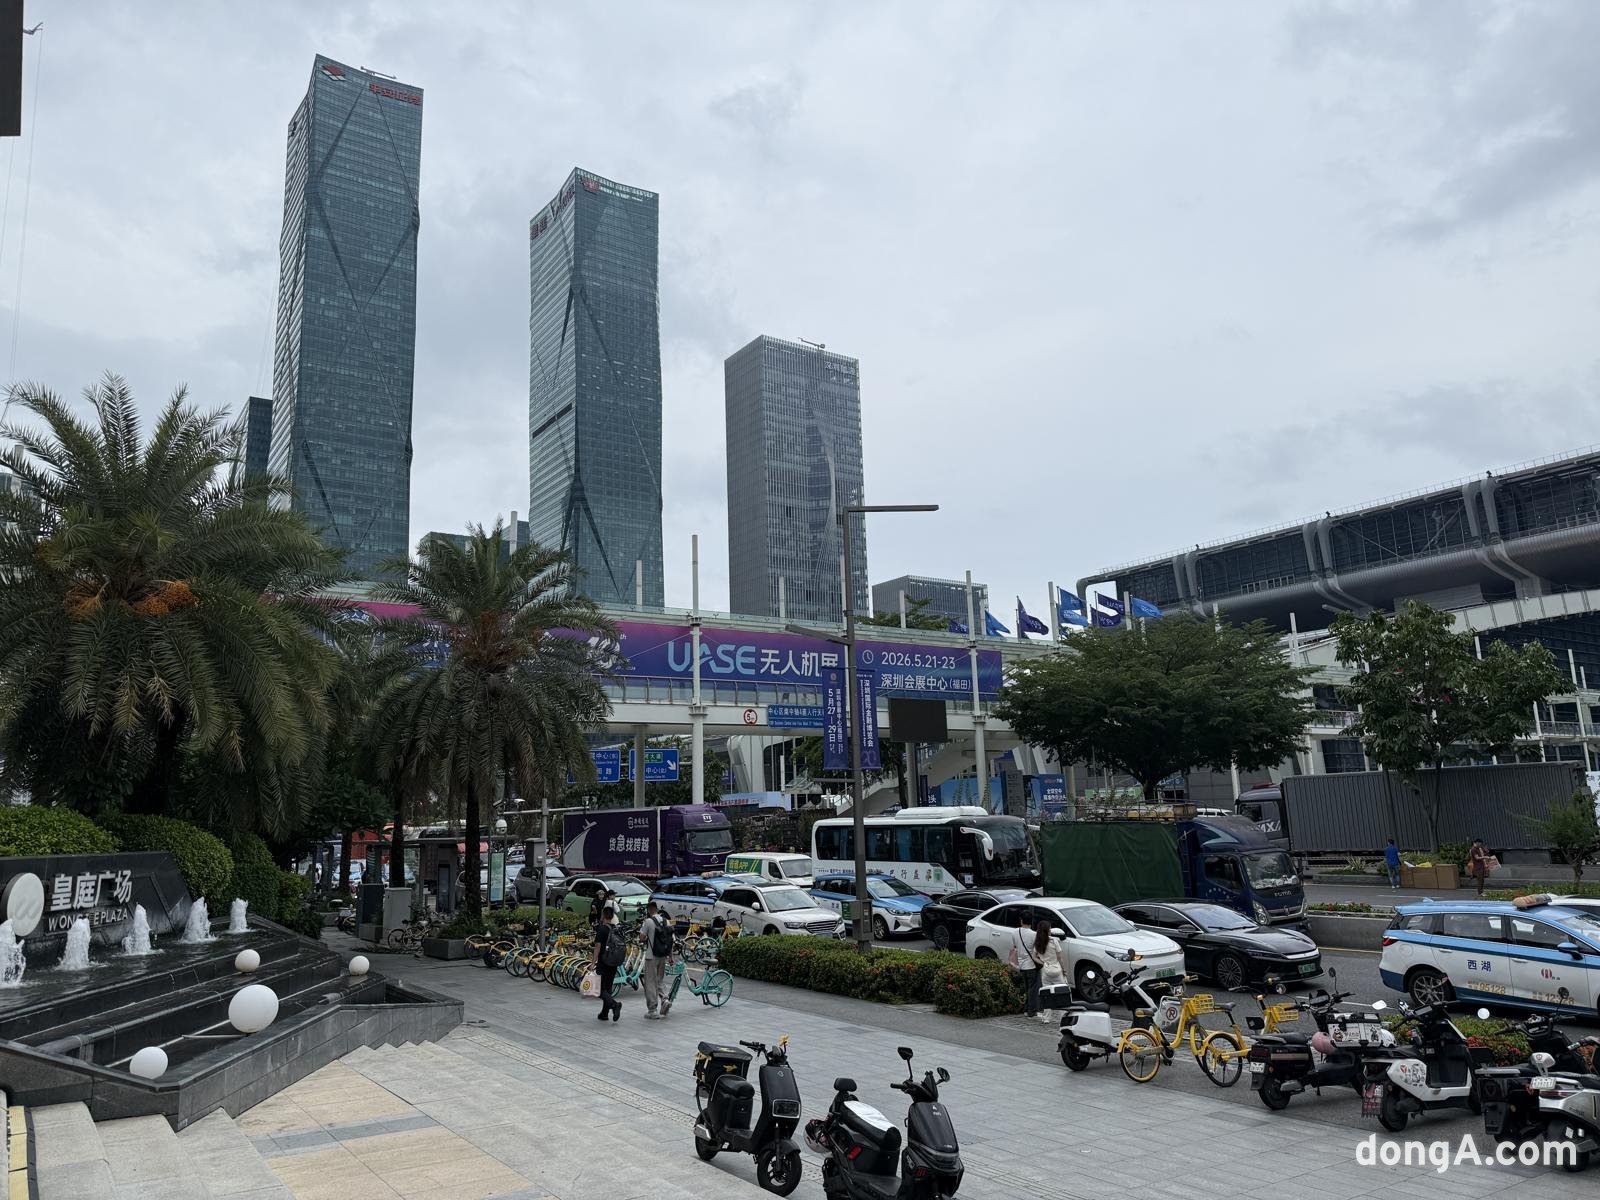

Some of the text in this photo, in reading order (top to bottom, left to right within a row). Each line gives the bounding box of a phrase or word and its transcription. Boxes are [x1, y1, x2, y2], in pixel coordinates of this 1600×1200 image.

[667, 641, 756, 675] UASE
[881, 652, 956, 669] 2026.5.21-23
[609, 834, 649, 852] 货急找跨越
[50, 870, 132, 911] 皇庭广场
[1467, 959, 1491, 972] 西湖
